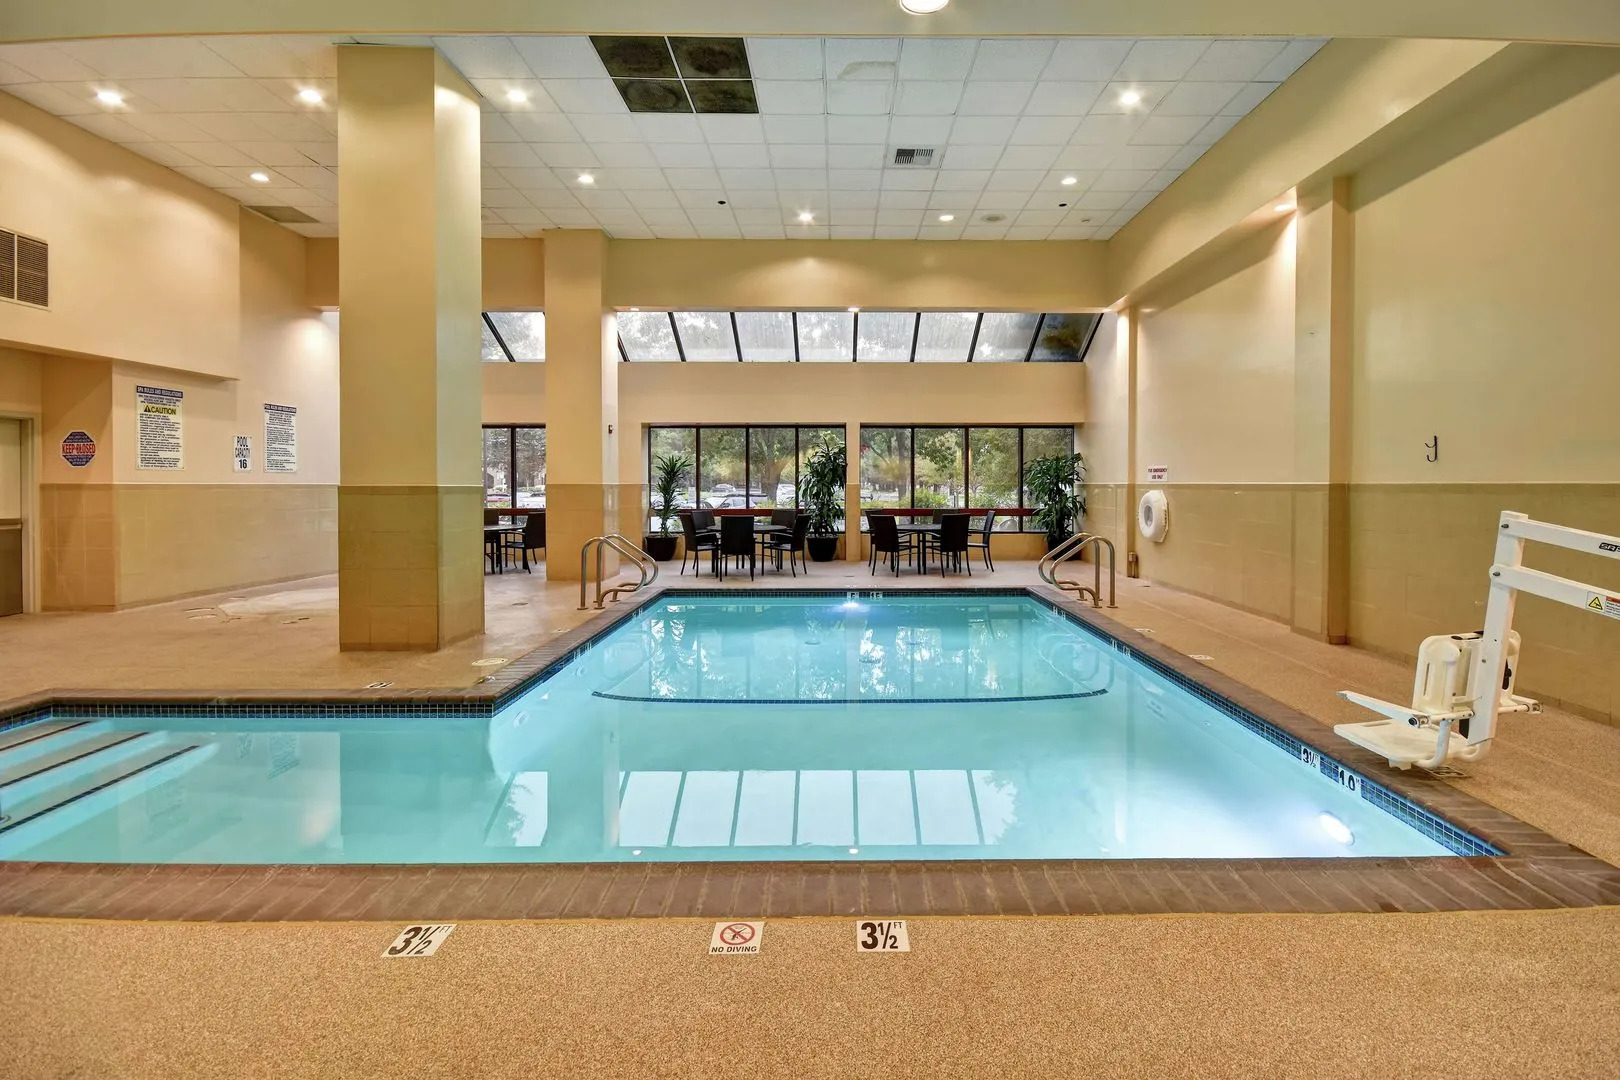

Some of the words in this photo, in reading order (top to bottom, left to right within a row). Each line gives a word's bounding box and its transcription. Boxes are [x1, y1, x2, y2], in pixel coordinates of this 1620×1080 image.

[151, 405, 176, 415] CAUTION
[237, 436, 248, 447] POOL
[62, 443, 75, 454] KEEP
[76, 443, 96, 454] CLOSED
[235, 447, 250, 458] CAPACITY
[239, 458, 248, 469] 16
[726, 945, 757, 953] DIVING
